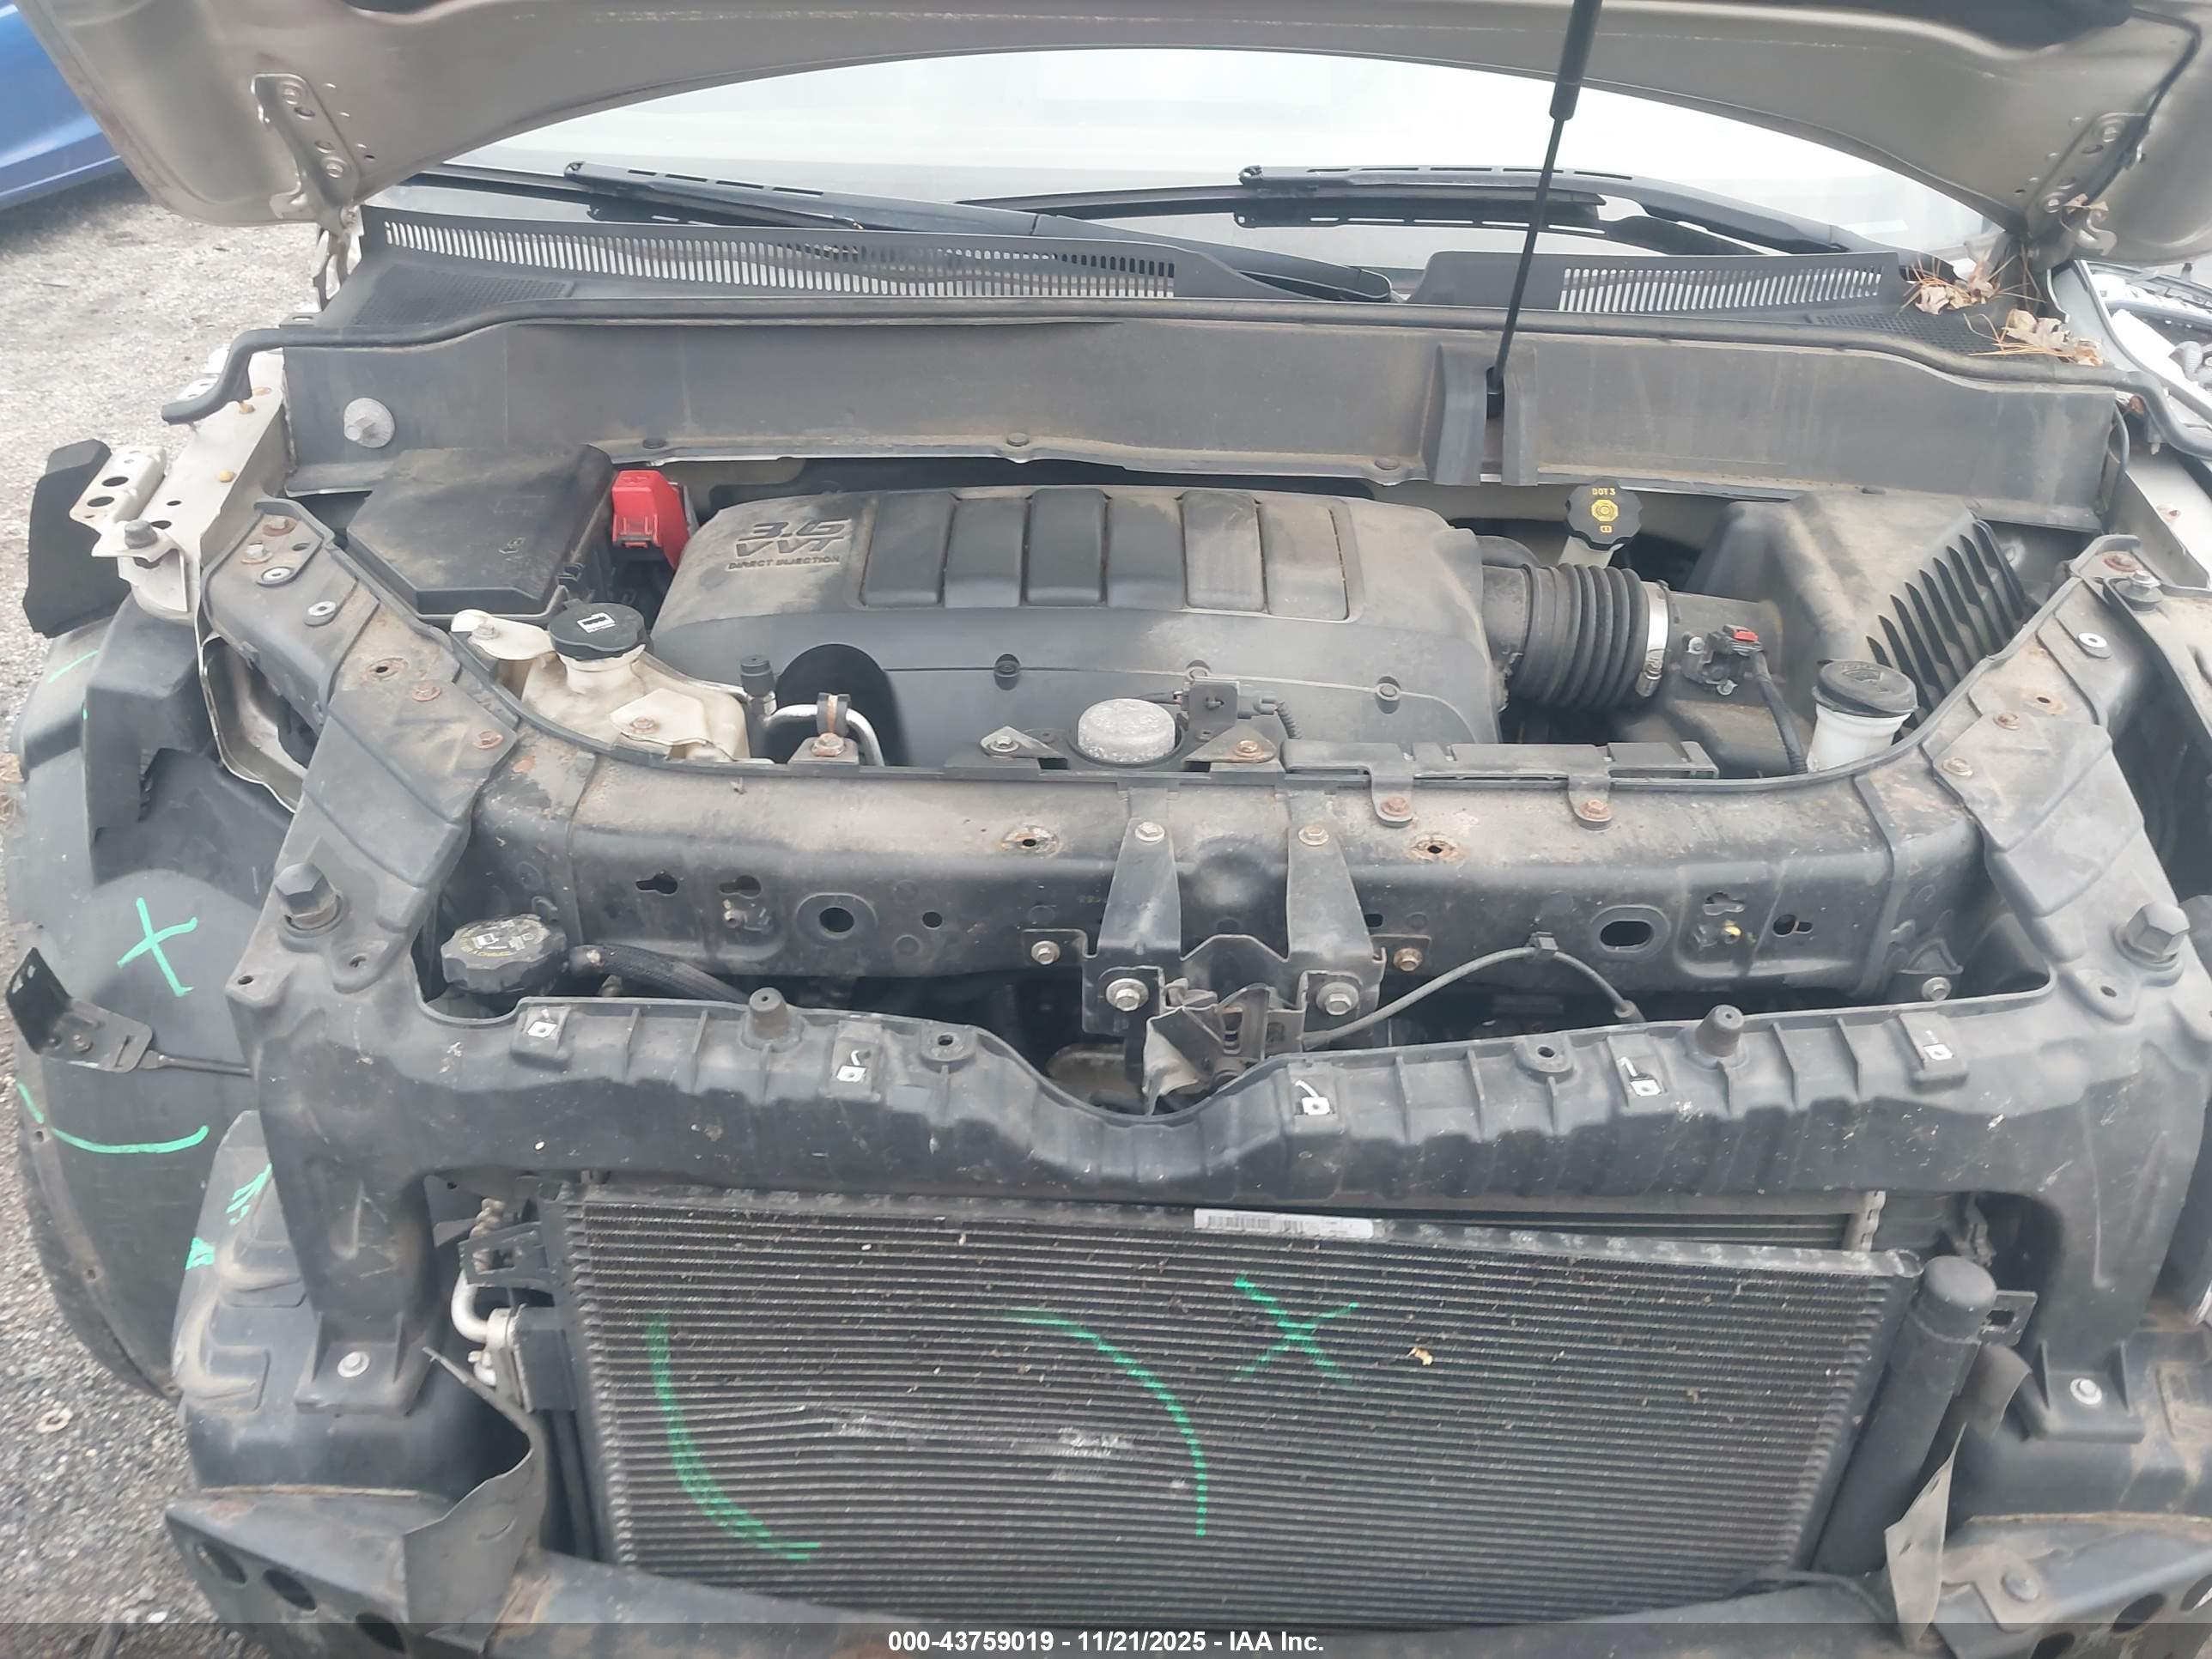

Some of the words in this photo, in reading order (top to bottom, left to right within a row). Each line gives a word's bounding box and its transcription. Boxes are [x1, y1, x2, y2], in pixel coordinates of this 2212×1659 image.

[1591, 487, 1608, 495] DOT
[738, 518, 852, 541] 3.6
[735, 536, 844, 557] VVT
[728, 558, 774, 570] DIRECT
[775, 556, 841, 568] INJECTION
